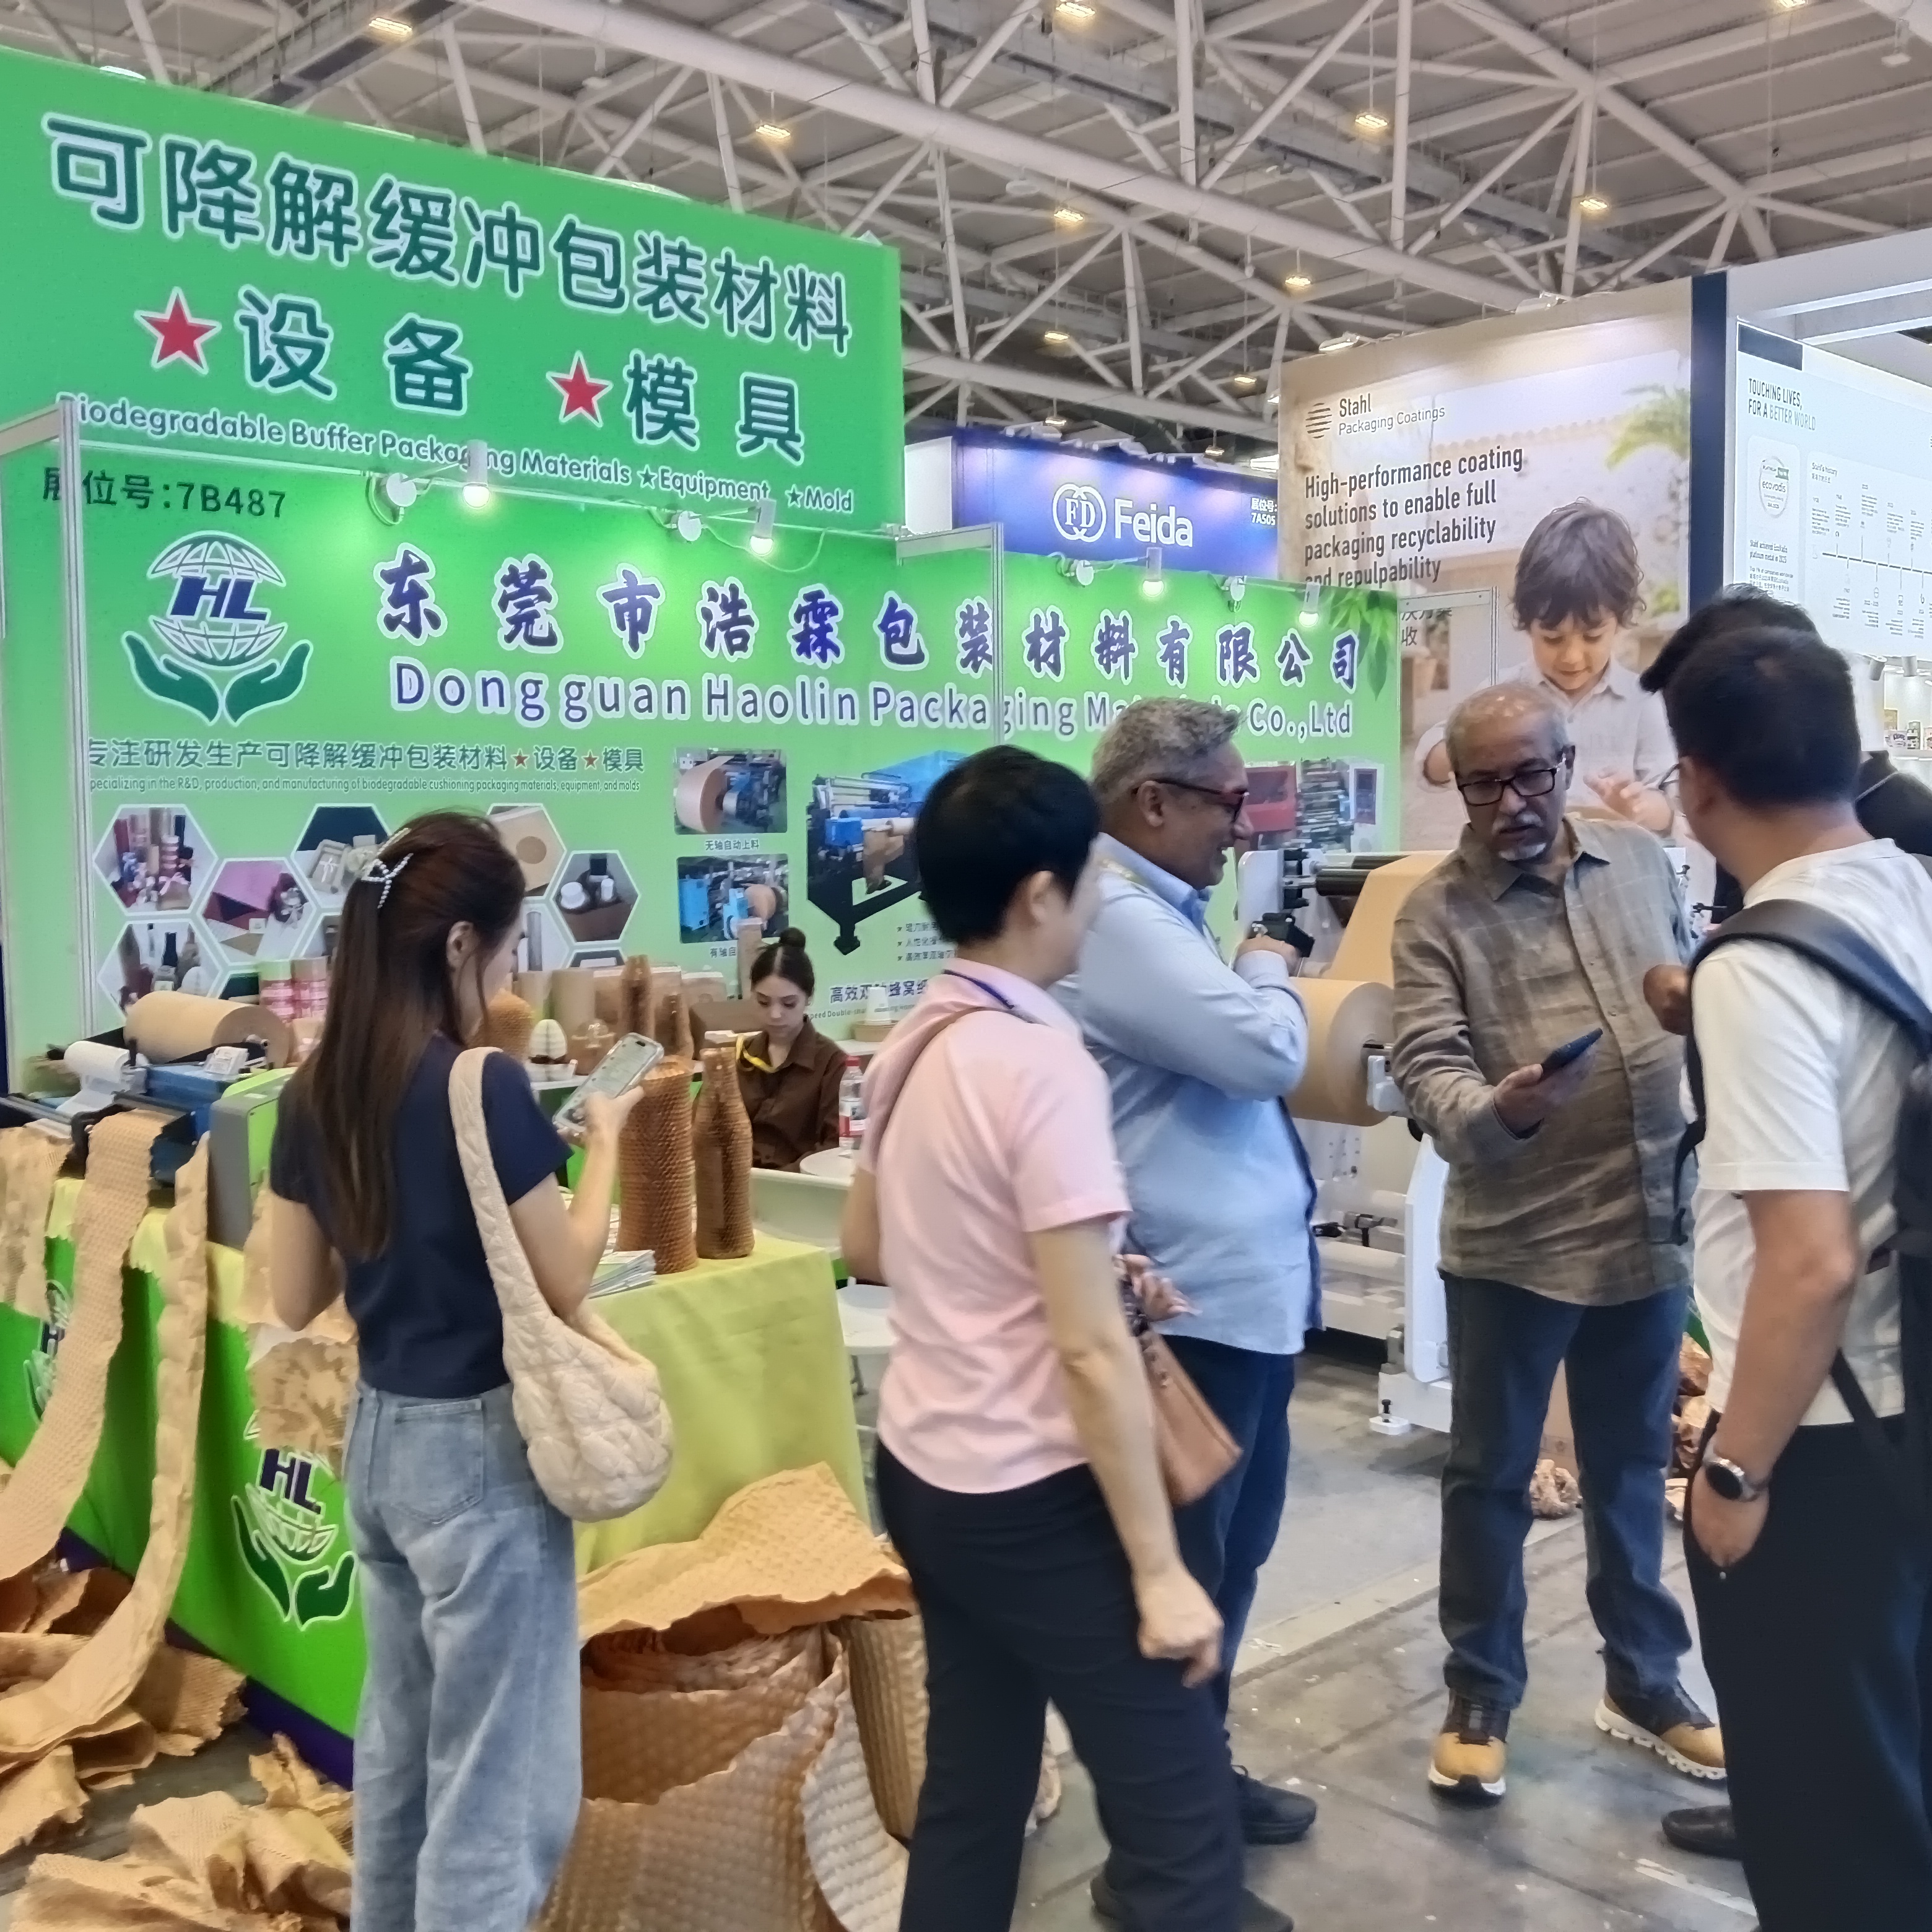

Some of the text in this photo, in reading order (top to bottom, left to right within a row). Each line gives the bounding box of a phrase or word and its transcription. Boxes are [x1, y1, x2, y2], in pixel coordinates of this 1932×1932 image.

[43, 115, 851, 354] 可降解缓冲包装材料
[1339, 393, 1372, 417] Stahl
[1748, 398, 1816, 431] FOR A BETTER WORLD
[1749, 378, 1803, 411] TOUCHING LIVES,
[1338, 407, 1445, 435] Packaging Coatings
[59, 394, 853, 512] iodegradable Buffer Packagng Materials Equipment Mold
[1305, 445, 1523, 502] High-performance coating
[1065, 498, 1096, 528] FD
[1115, 498, 1193, 547] Feida
[1305, 479, 1497, 529] solutions to enable full
[1305, 516, 1496, 567] packaging recyclability
[1338, 555, 1442, 588] repulpability
[170, 575, 268, 621] HL
[378, 549, 1357, 690] 东莞市浩霖包装材料有限公司
[707, 679, 856, 720] Haolin
[90, 776, 146, 792] pecializing
[159, 777, 175, 789] the
[205, 777, 260, 793] production,
[262, 777, 280, 790] and
[282, 777, 349, 793] manufacturing
[351, 778, 361, 790] of
[362, 777, 427, 793] biodegradable
[429, 777, 474, 793] cushioning
[476, 778, 519, 793] packaging
[604, 780, 617, 790] and
[619, 780, 640, 791] molds
[807, 1011, 826, 1020] peed
[260, 1448, 322, 1515] HL
